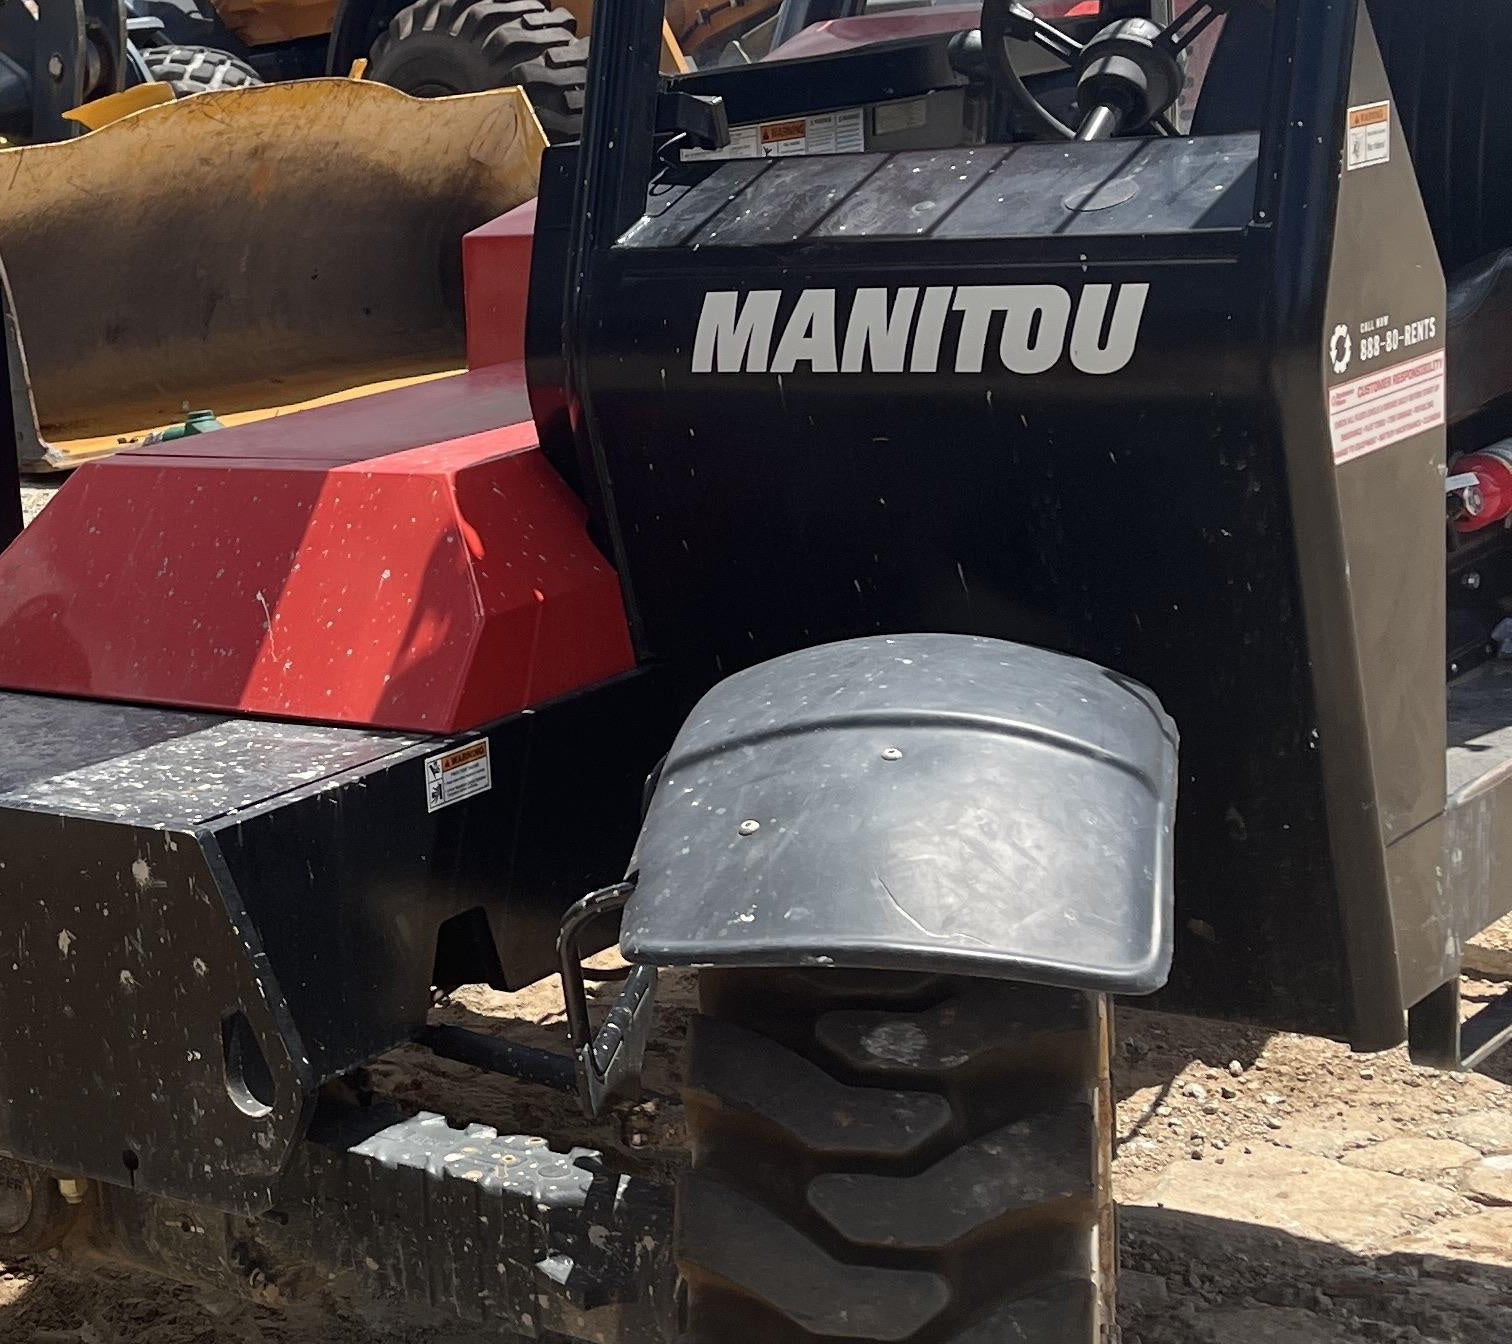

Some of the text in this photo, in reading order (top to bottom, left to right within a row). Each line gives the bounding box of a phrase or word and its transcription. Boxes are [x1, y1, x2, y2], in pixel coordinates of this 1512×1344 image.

[691, 283, 1150, 375] MANITOU
[1359, 314, 1389, 334] CALL NOW
[1359, 316, 1436, 361] 888-80-RENTS
